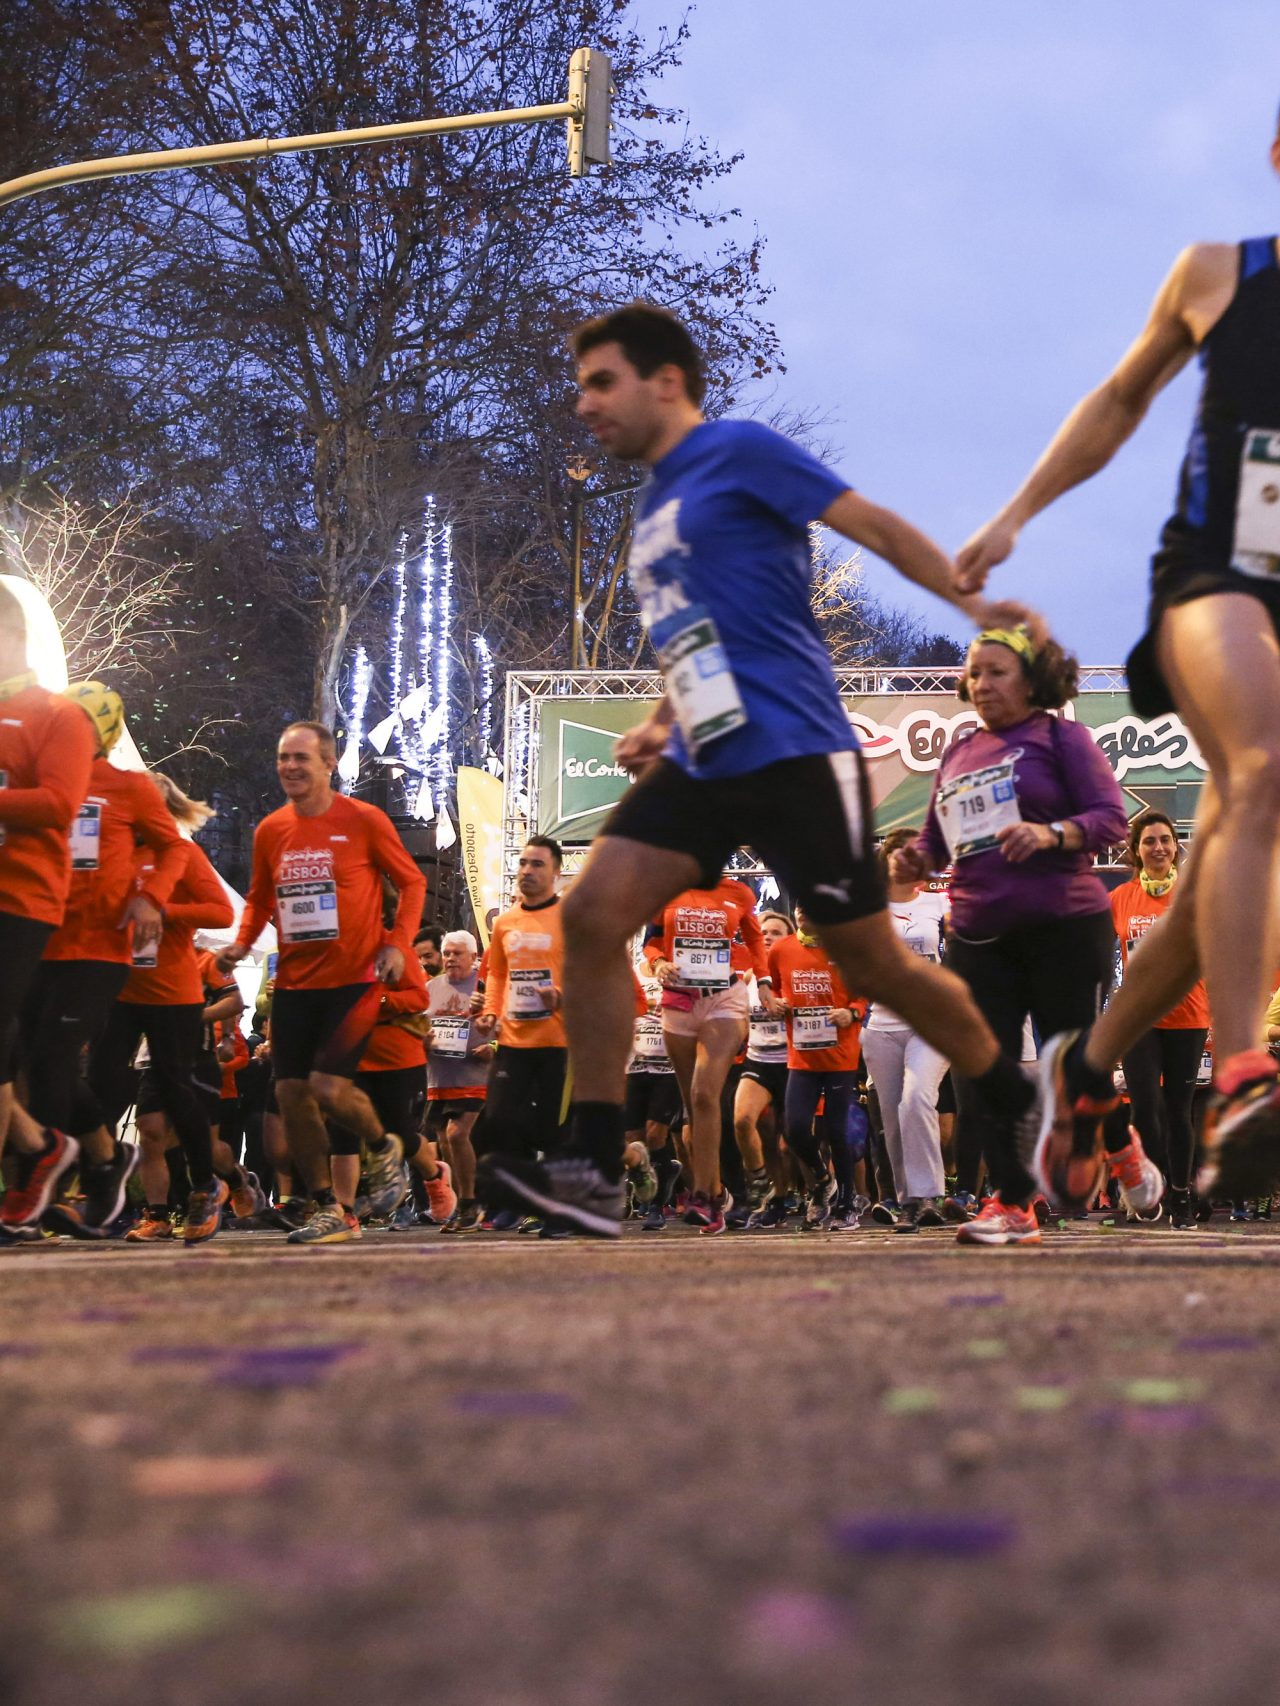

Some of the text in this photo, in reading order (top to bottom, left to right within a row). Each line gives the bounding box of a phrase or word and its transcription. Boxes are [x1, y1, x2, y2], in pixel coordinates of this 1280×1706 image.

[565, 758, 584, 777] El
[959, 795, 985, 818] 719
[281, 865, 331, 881] LISBOA
[677, 922, 724, 935] LISBOA
[1130, 930, 1147, 940] LIS
[793, 983, 831, 993] LISBOA
